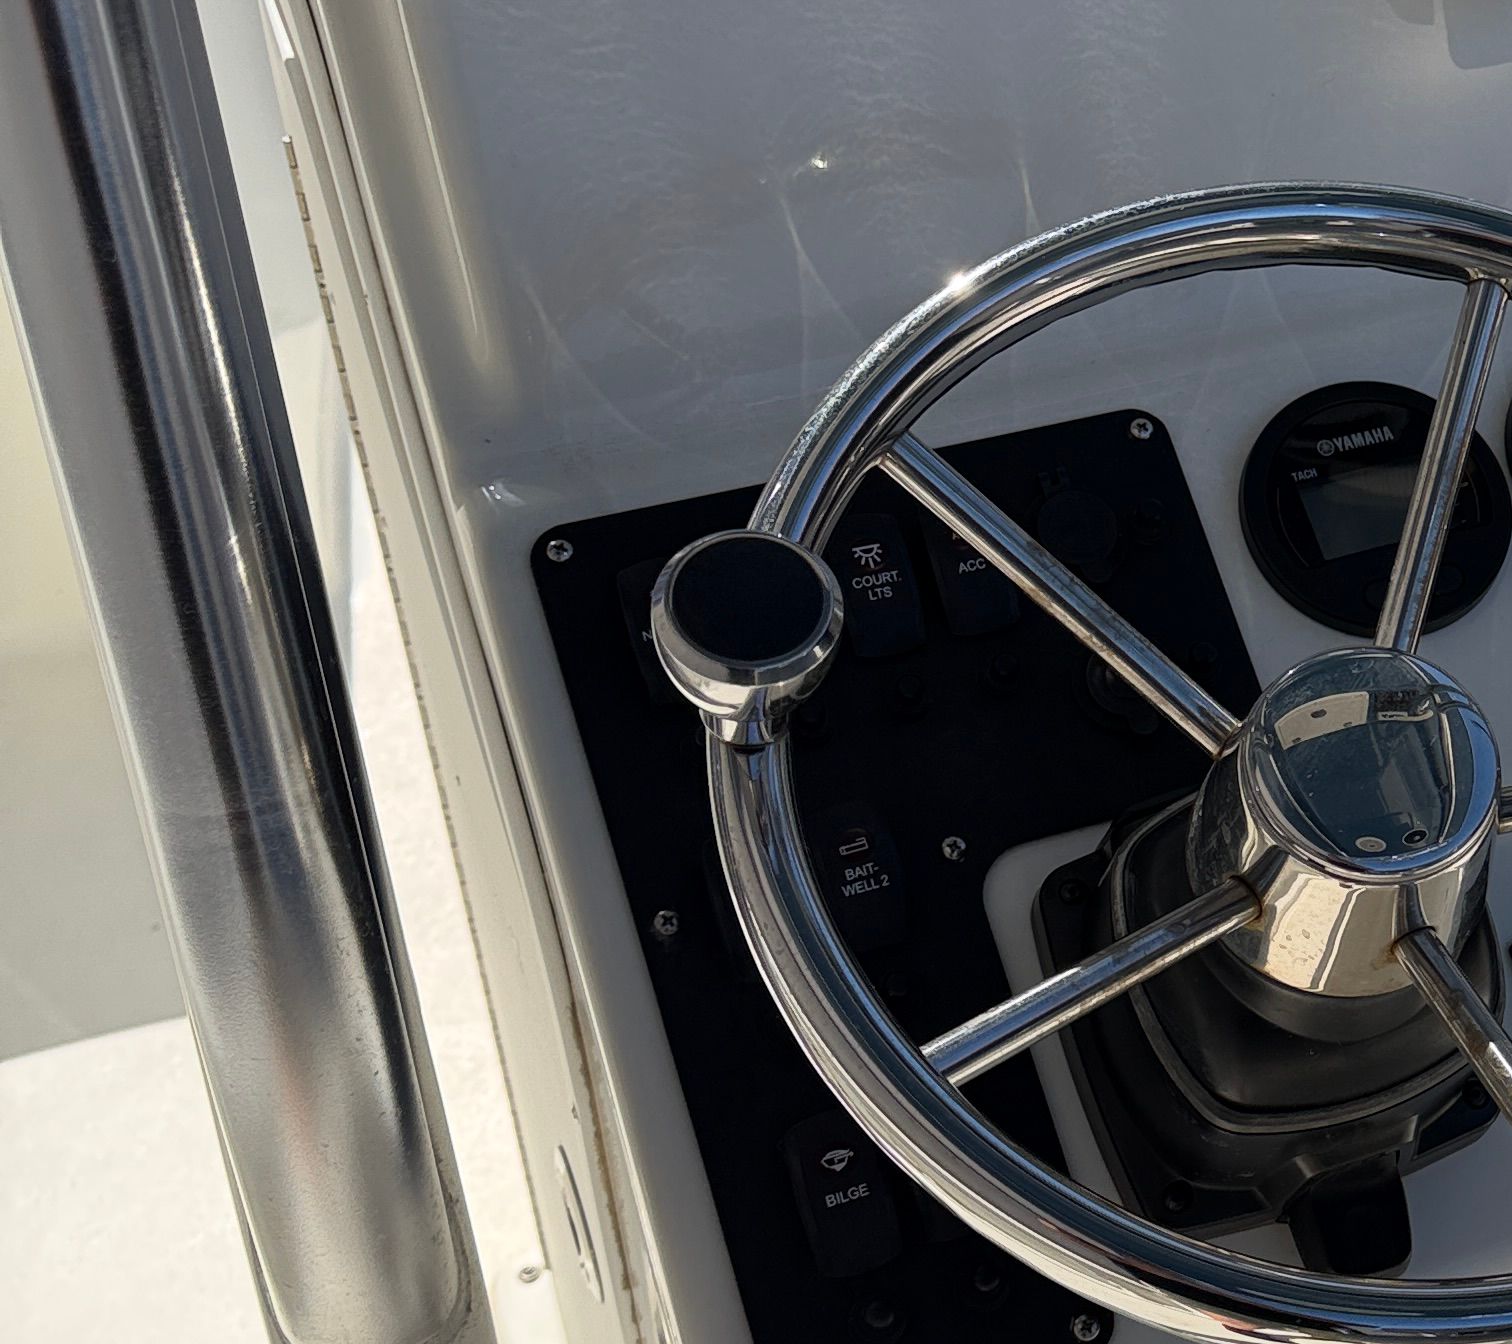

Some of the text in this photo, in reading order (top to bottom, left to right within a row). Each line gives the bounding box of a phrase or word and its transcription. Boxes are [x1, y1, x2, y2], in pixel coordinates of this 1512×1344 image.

[1332, 425, 1394, 453] YAMAHA
[1290, 467, 1318, 483] TACH
[958, 557, 987, 575] ACC
[868, 585, 893, 601] LTS
[844, 861, 880, 882] BAIT-
[841, 873, 891, 899] WELL 2
[825, 1183, 871, 1208] BILGE
